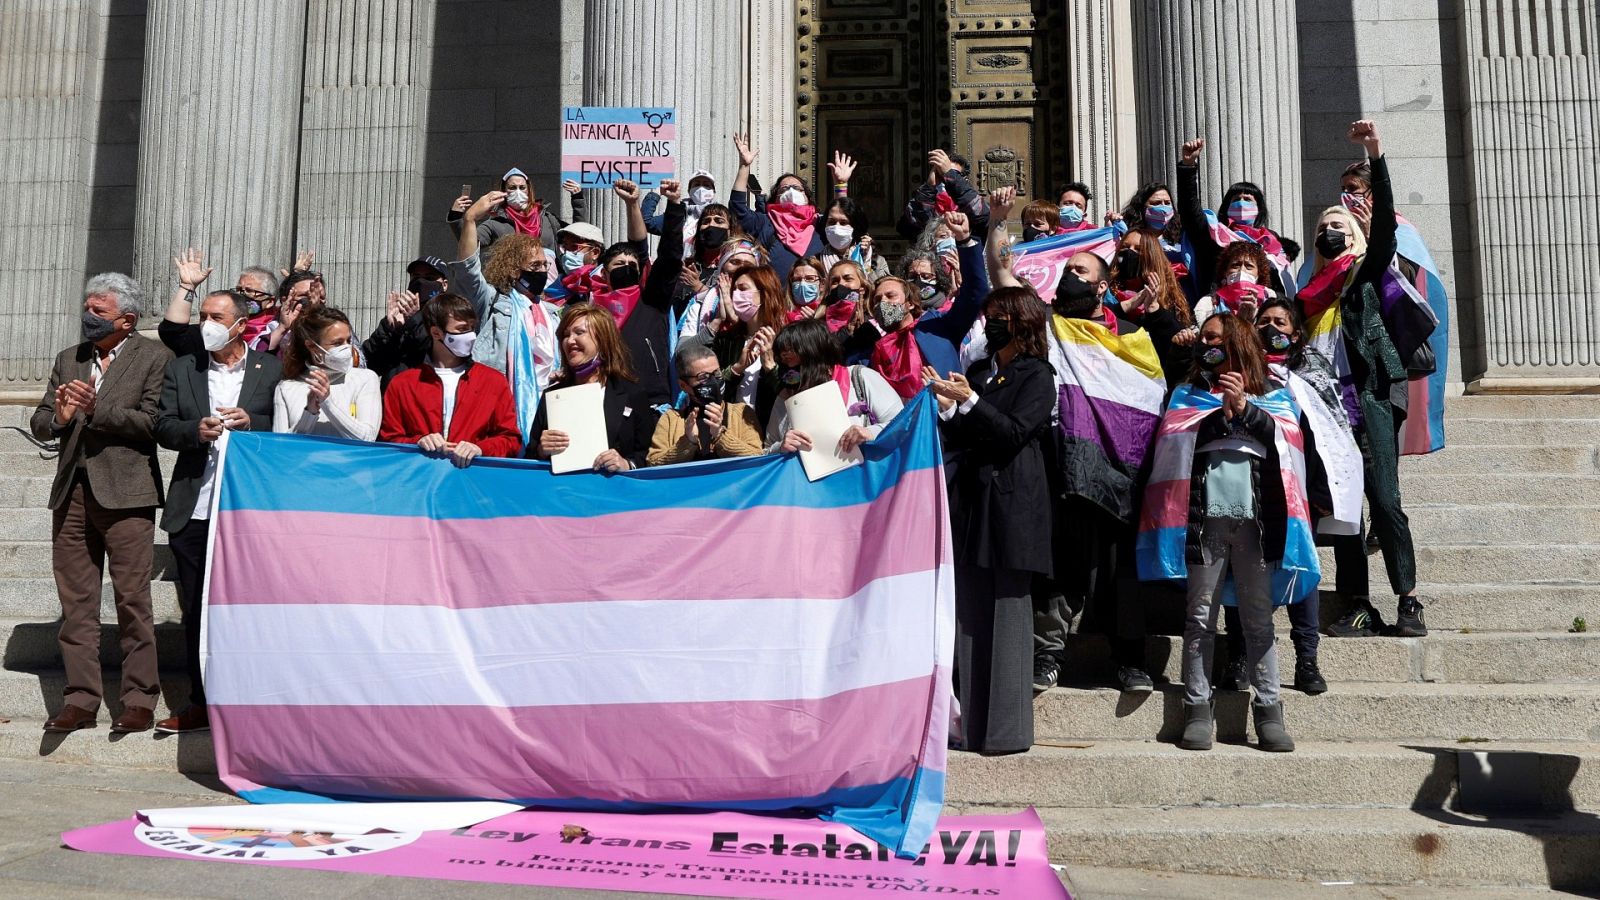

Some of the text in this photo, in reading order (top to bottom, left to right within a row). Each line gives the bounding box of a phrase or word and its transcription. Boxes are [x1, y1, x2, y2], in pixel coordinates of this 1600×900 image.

[567, 108, 585, 120] LA
[564, 124, 631, 140] INFANCIA
[625, 141, 670, 157] TRANS
[581, 161, 652, 185] EXISTE
[449, 825, 540, 843] Ley
[709, 832, 889, 862] Estatal
[530, 855, 665, 869] Personas
[781, 870, 905, 882] binarias
[664, 872, 712, 880] sus
[723, 874, 854, 888] Familias
[866, 883, 1001, 895] UNIDAS
